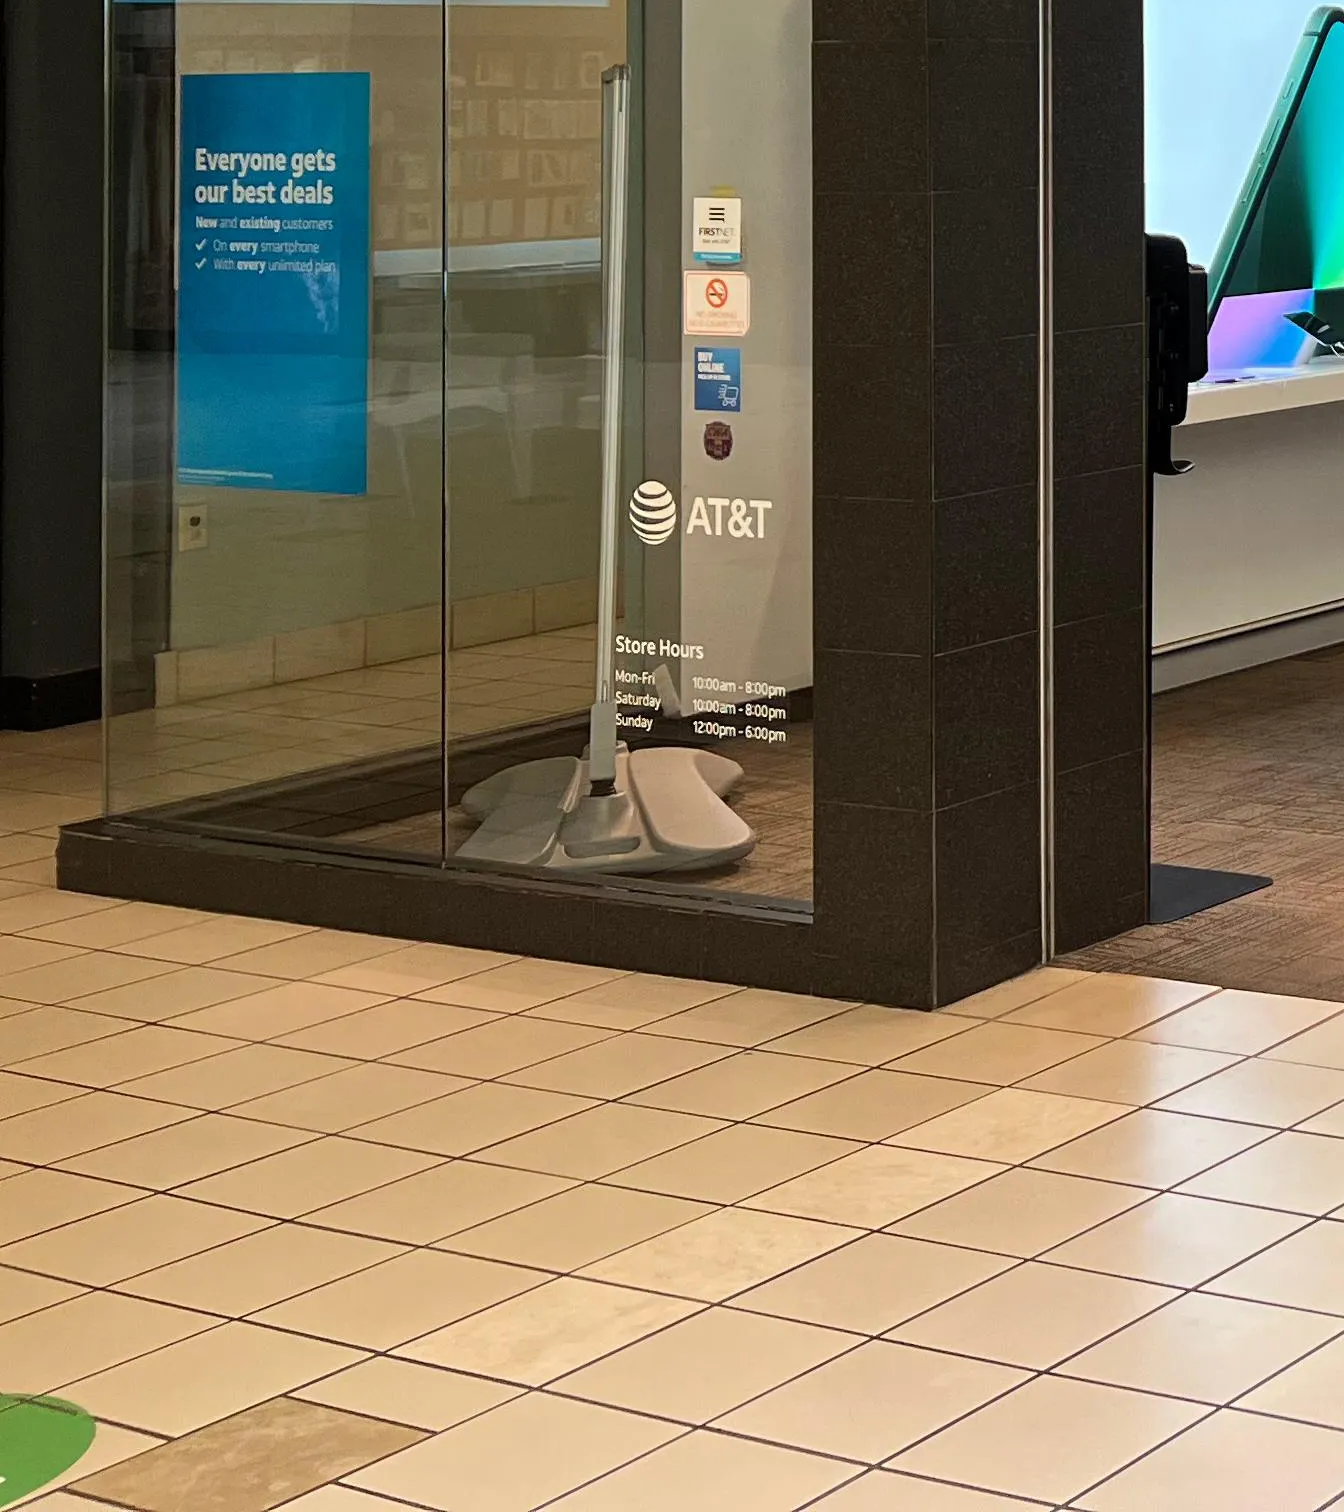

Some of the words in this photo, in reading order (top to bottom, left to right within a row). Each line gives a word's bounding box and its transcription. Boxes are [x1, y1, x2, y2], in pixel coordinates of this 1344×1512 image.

[195, 148, 287, 178] Everyone
[291, 148, 336, 178] gets
[194, 184, 228, 204] our
[232, 179, 277, 204] best
[280, 179, 334, 205] deals
[195, 216, 218, 229] New
[219, 217, 238, 229] and
[239, 217, 281, 232] existing
[282, 218, 334, 230] customers
[213, 239, 228, 251] On
[229, 241, 259, 255] every
[260, 240, 320, 254] smartphone
[213, 259, 235, 270] With
[237, 260, 266, 274] every
[268, 260, 313, 273] unlimited
[315, 261, 337, 274] plan
[686, 496, 773, 539] AT&T
[615, 635, 656, 656] Store
[659, 638, 704, 659] Hours
[615, 669, 656, 685] Mon-Fri
[692, 676, 737, 693] 10:00am
[745, 681, 786, 699] 8:00pm
[615, 691, 661, 711] Saturday
[692, 698, 737, 715] 10:00am
[745, 704, 786, 721] 8:00pm
[615, 713, 654, 732] Sunday
[692, 720, 737, 739] 12:00pm
[745, 725, 786, 743] 6:00pm
